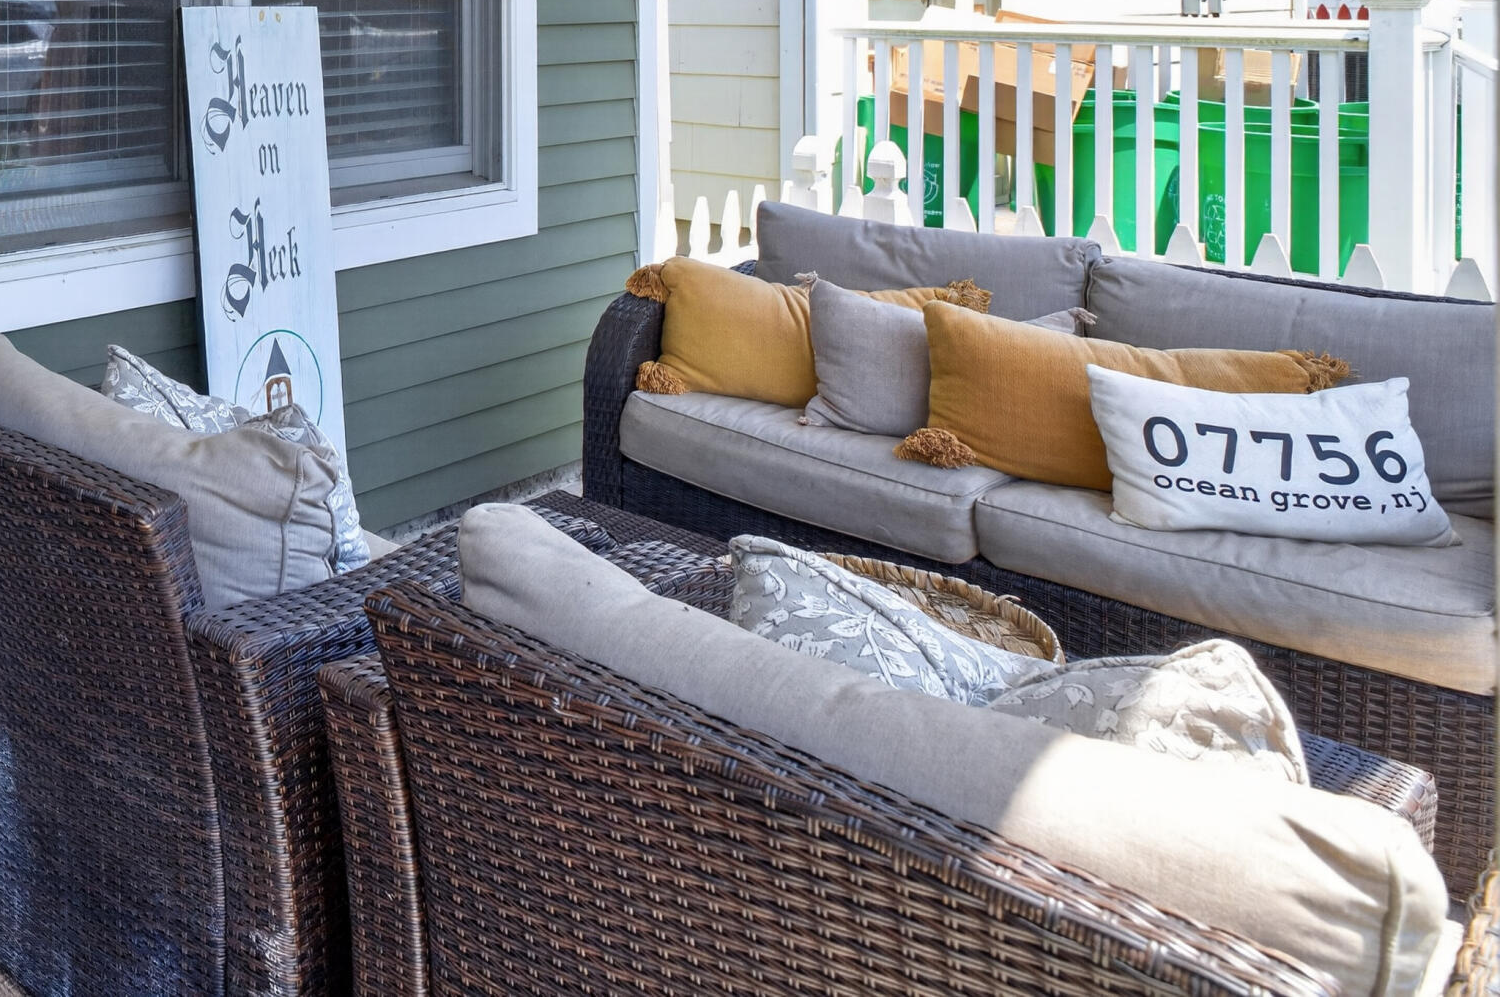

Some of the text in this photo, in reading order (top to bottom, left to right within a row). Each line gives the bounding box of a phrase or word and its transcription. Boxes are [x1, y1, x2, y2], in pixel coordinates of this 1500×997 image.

[200, 34, 310, 155] Heaven
[258, 143, 281, 176] on
[220, 197, 302, 322] Heck
[1143, 416, 1408, 486] 07756
[1154, 475, 1260, 502] ocean
